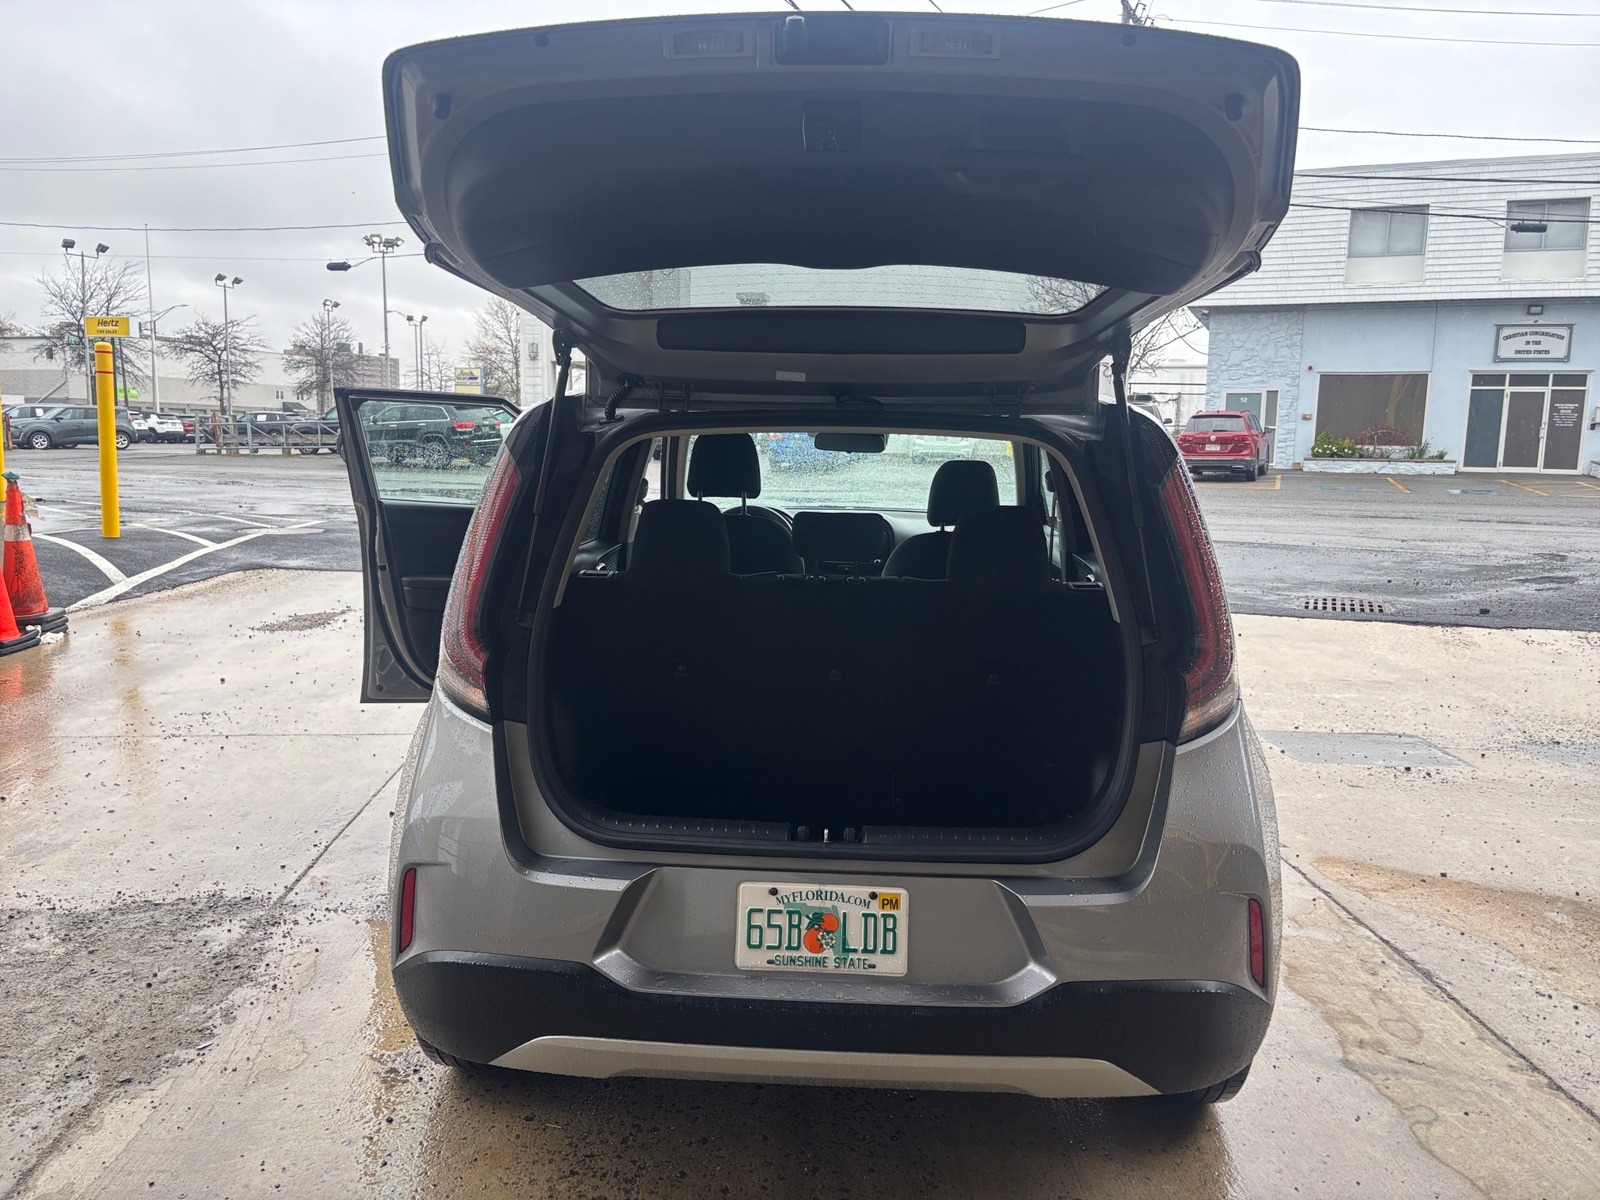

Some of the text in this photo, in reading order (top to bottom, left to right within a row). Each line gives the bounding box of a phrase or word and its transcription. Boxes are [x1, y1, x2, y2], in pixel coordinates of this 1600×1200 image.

[97, 319, 119, 327] Hertz
[1503, 331, 1565, 341] CHRISTIAN CONGREGATION
[776, 890, 871, 909] MYFLORIDA.COM
[881, 898, 899, 911] PM
[746, 907, 898, 955] 65B LDB
[774, 955, 869, 970] SUNSHINE STATE
